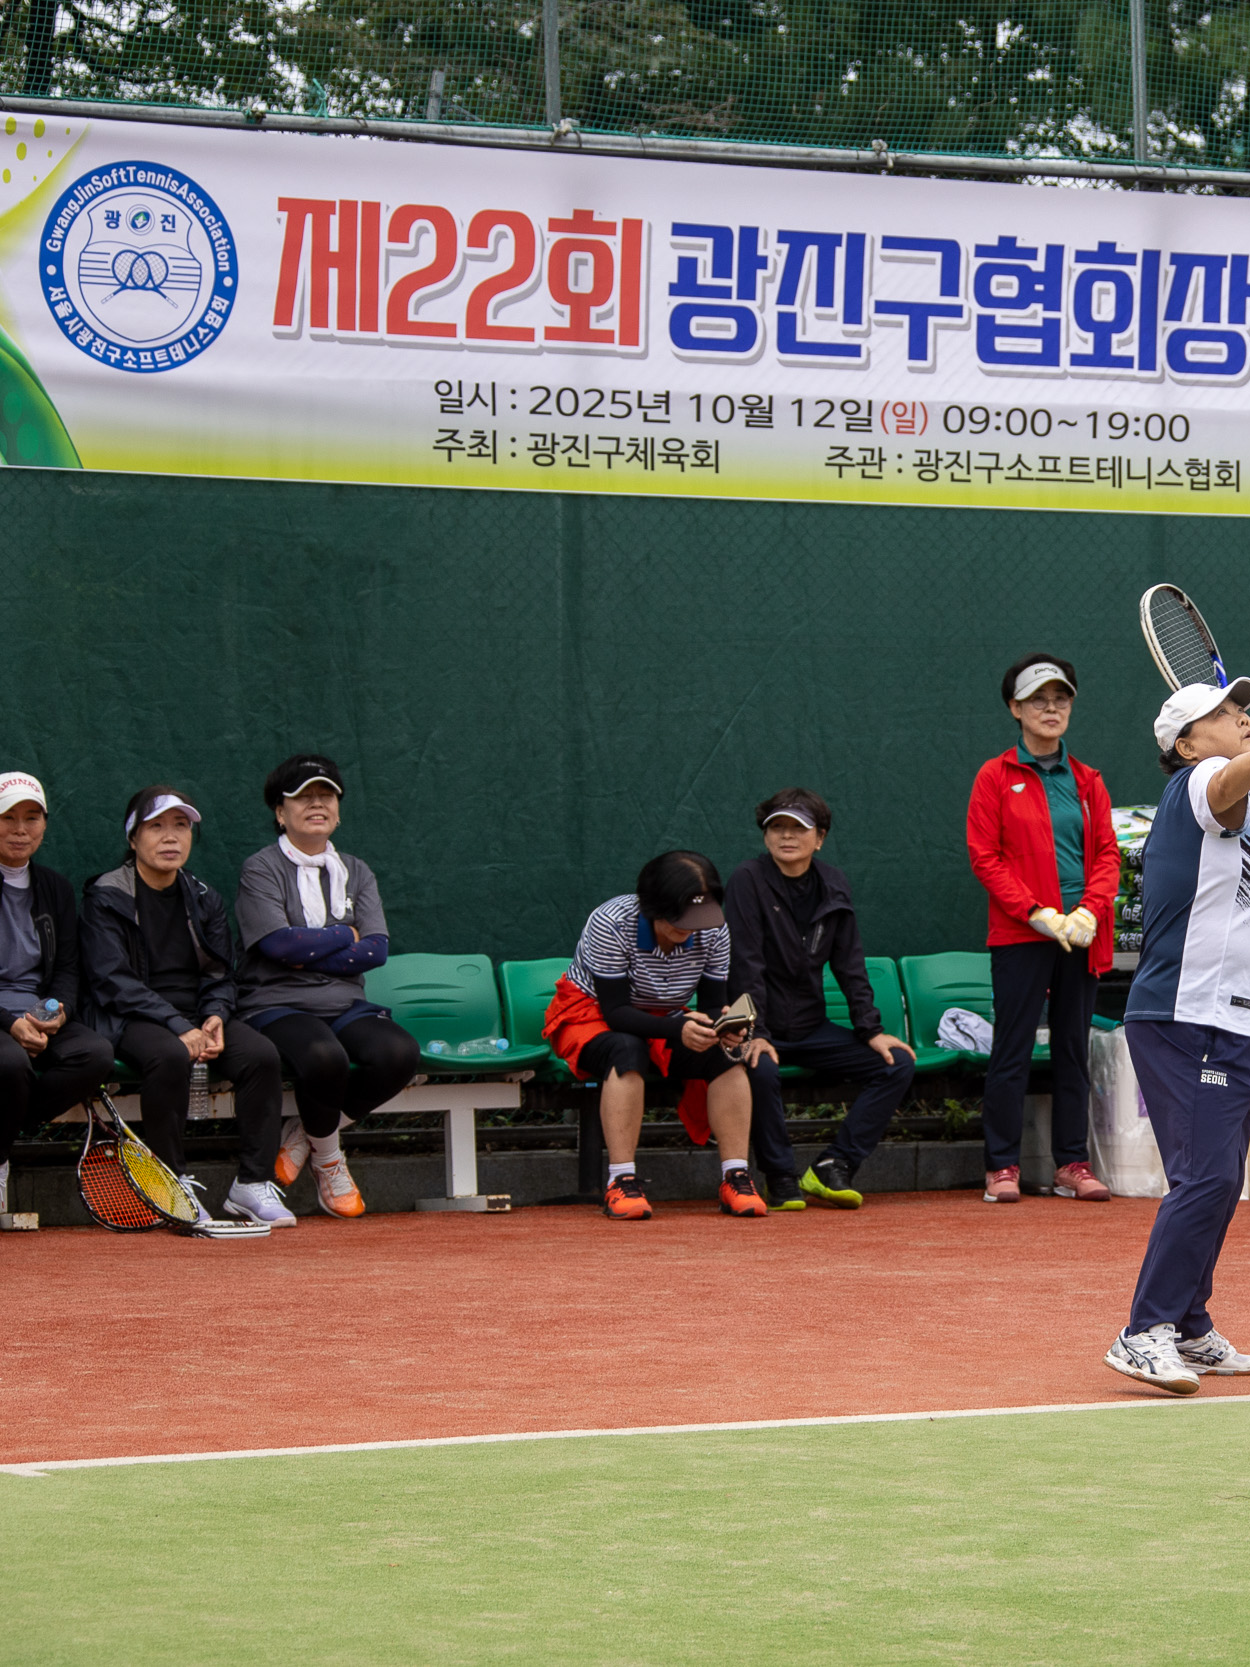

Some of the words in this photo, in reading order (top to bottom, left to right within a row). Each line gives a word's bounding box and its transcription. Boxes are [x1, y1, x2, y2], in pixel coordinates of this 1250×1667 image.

[45, 166, 231, 272] GwangJinSoftTennisAssociation
[104, 210, 121, 229] 광
[160, 213, 176, 233] 진
[272, 196, 644, 347] 제22회
[48, 285, 230, 369] 서울시광진구소프트테니스협회
[433, 379, 498, 417] 일시
[528, 385, 672, 424] 2025년
[688, 393, 775, 430] 10월
[790, 397, 929, 436] 12일(일)
[942, 404, 1191, 443] 09:00~19:00
[432, 427, 498, 465] 주최
[526, 432, 721, 474] 광진구체육회
[824, 444, 887, 480] 주관
[912, 448, 1241, 493] 광진구소프트테니스협회
[1200, 1073, 1229, 1087] SEOUL
